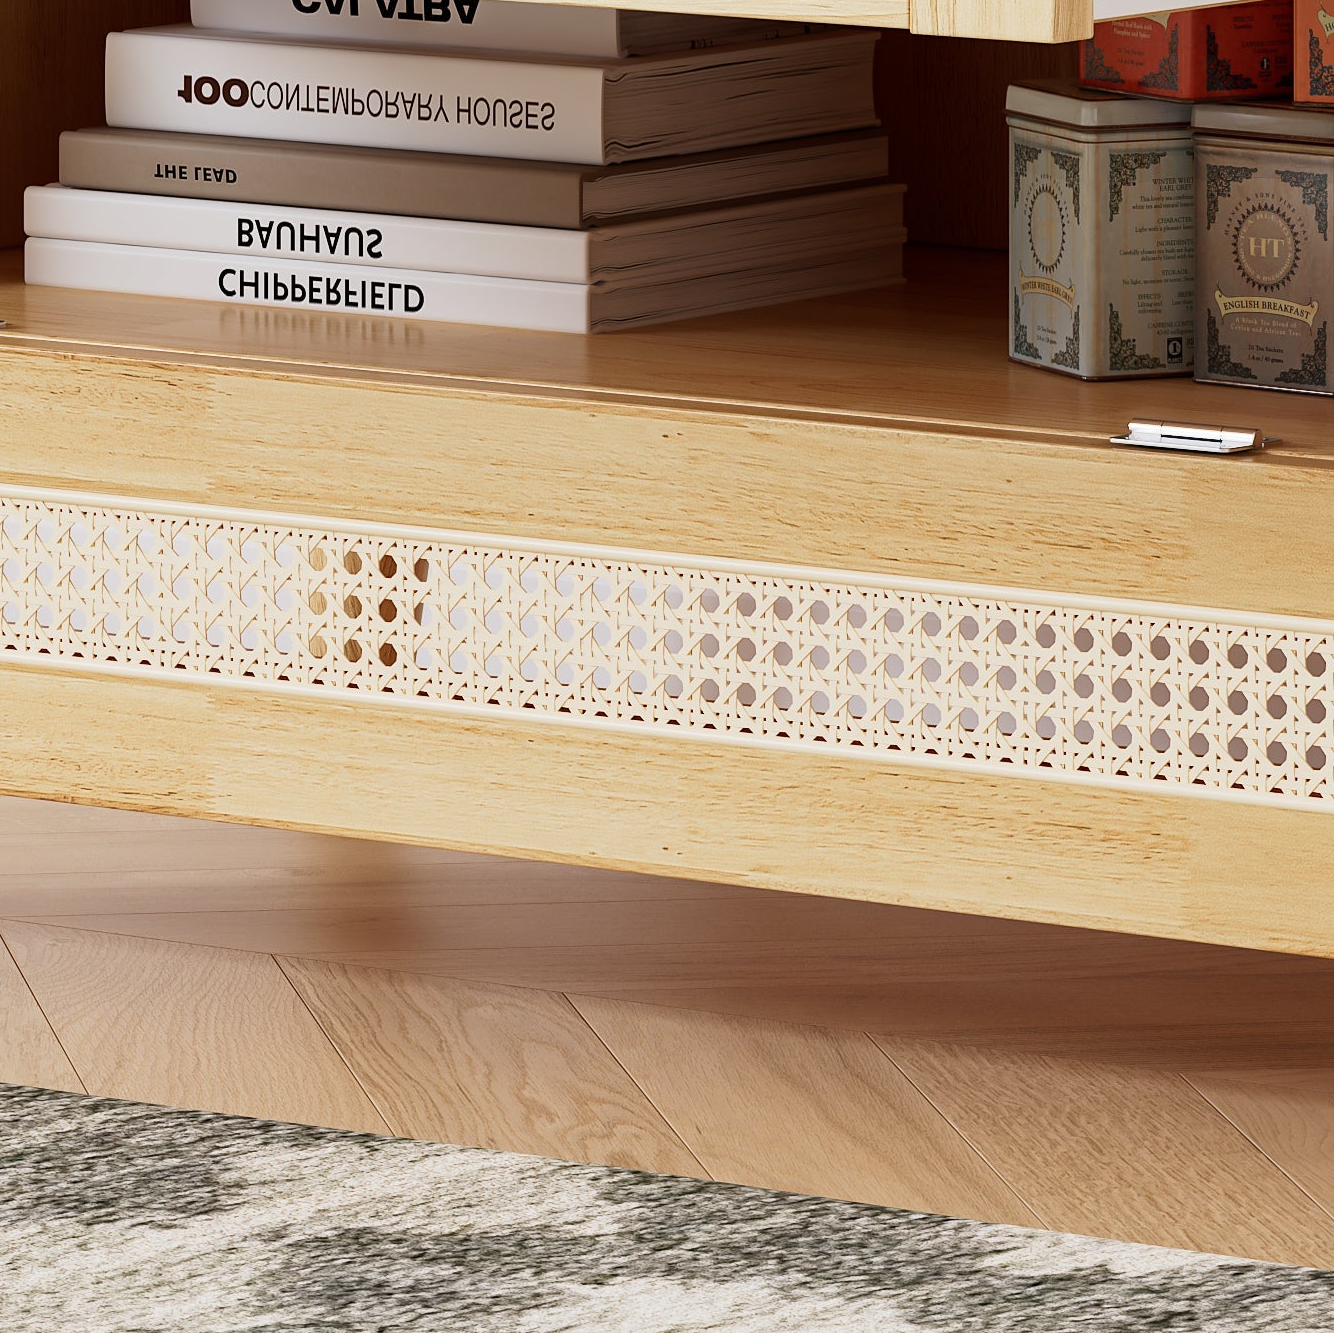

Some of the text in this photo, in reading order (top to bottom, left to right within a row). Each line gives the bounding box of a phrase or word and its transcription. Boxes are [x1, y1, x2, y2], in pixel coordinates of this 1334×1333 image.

[1159, 184, 1175, 192] EARL
[1248, 237, 1285, 258] HT
[1223, 300, 1311, 320] ENGLISH BREAKFAST
